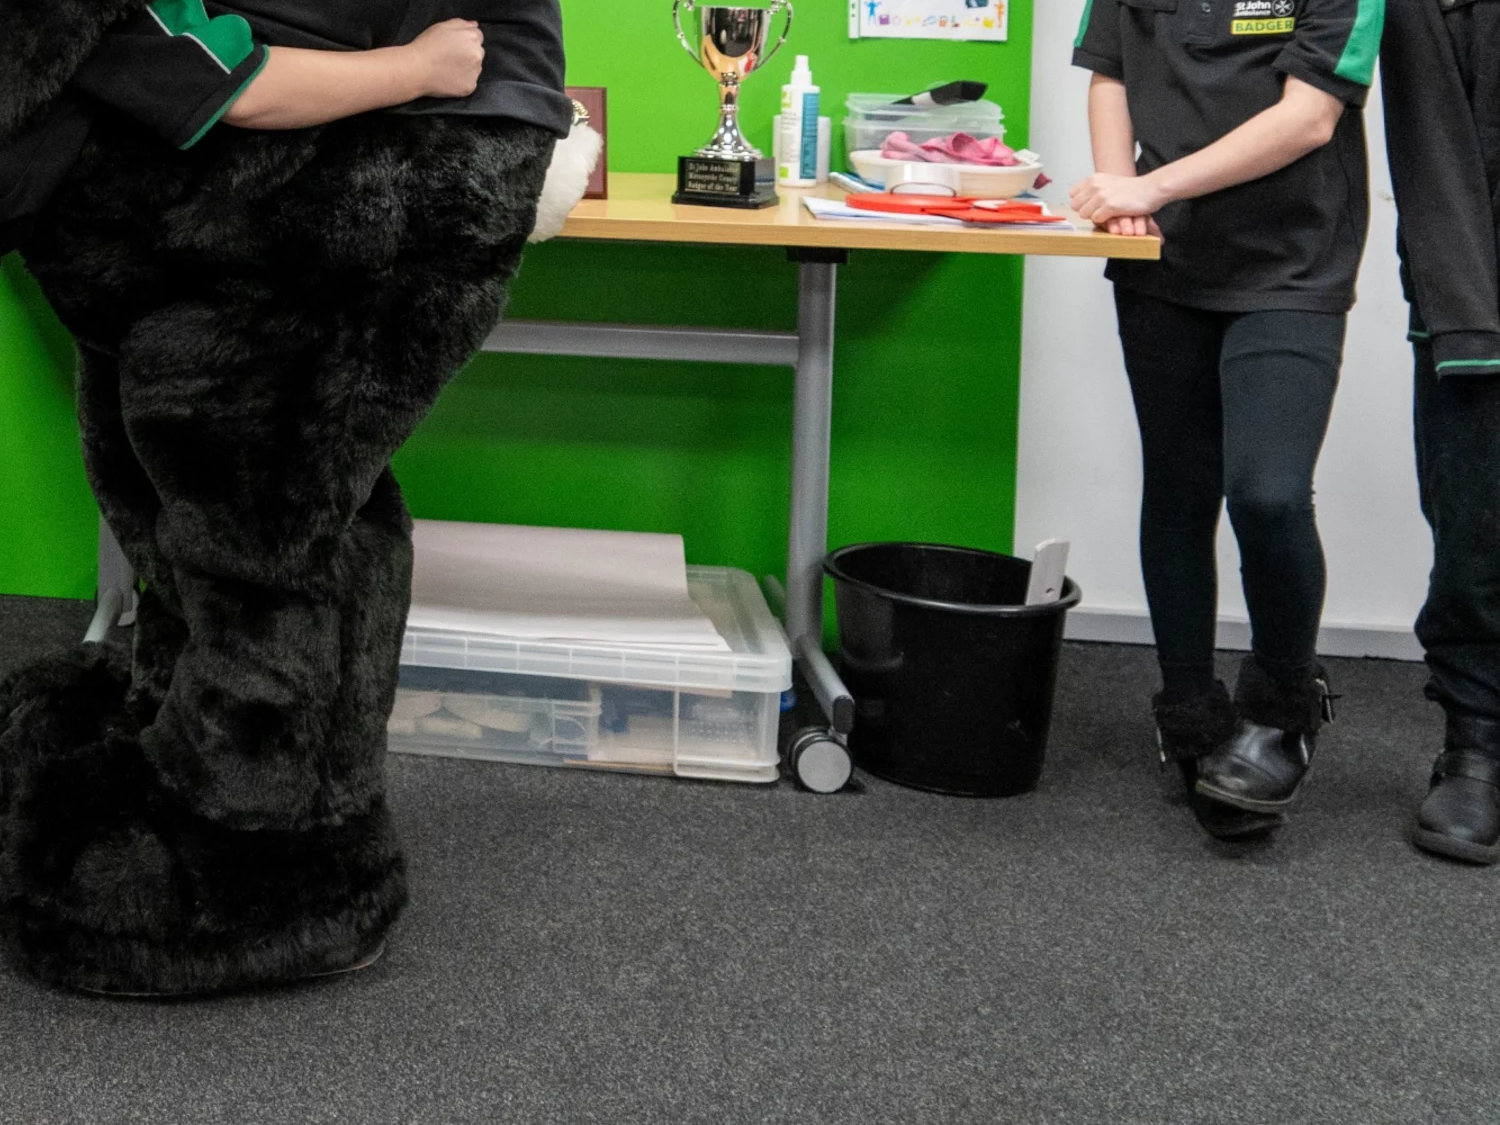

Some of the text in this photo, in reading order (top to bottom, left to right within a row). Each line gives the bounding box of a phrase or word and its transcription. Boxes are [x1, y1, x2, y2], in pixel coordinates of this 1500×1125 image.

[1235, 0, 1272, 11] St John
[1235, 20, 1294, 32] BADGER
